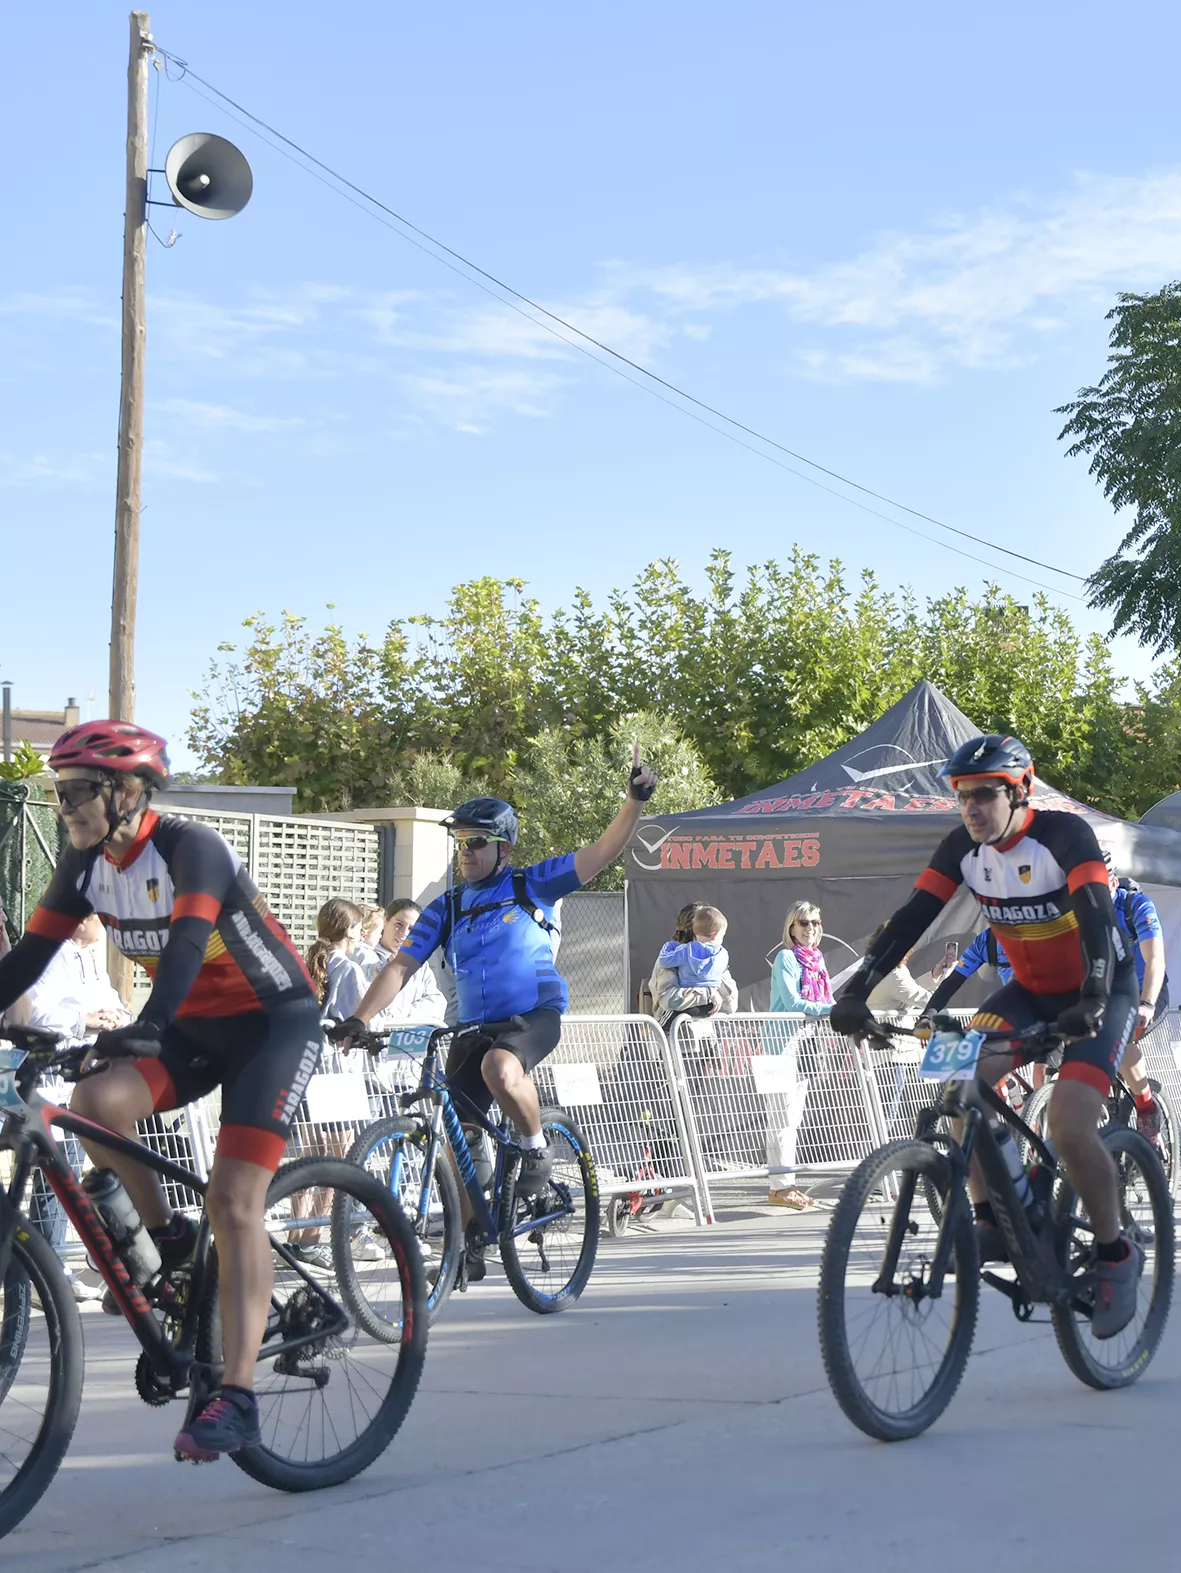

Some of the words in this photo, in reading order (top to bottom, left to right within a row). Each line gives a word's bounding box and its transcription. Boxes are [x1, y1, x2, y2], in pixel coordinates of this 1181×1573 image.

[396, 1030, 426, 1047] 103
[929, 1040, 973, 1063] 379
[280, 1040, 320, 1126] ZARAGOZA
